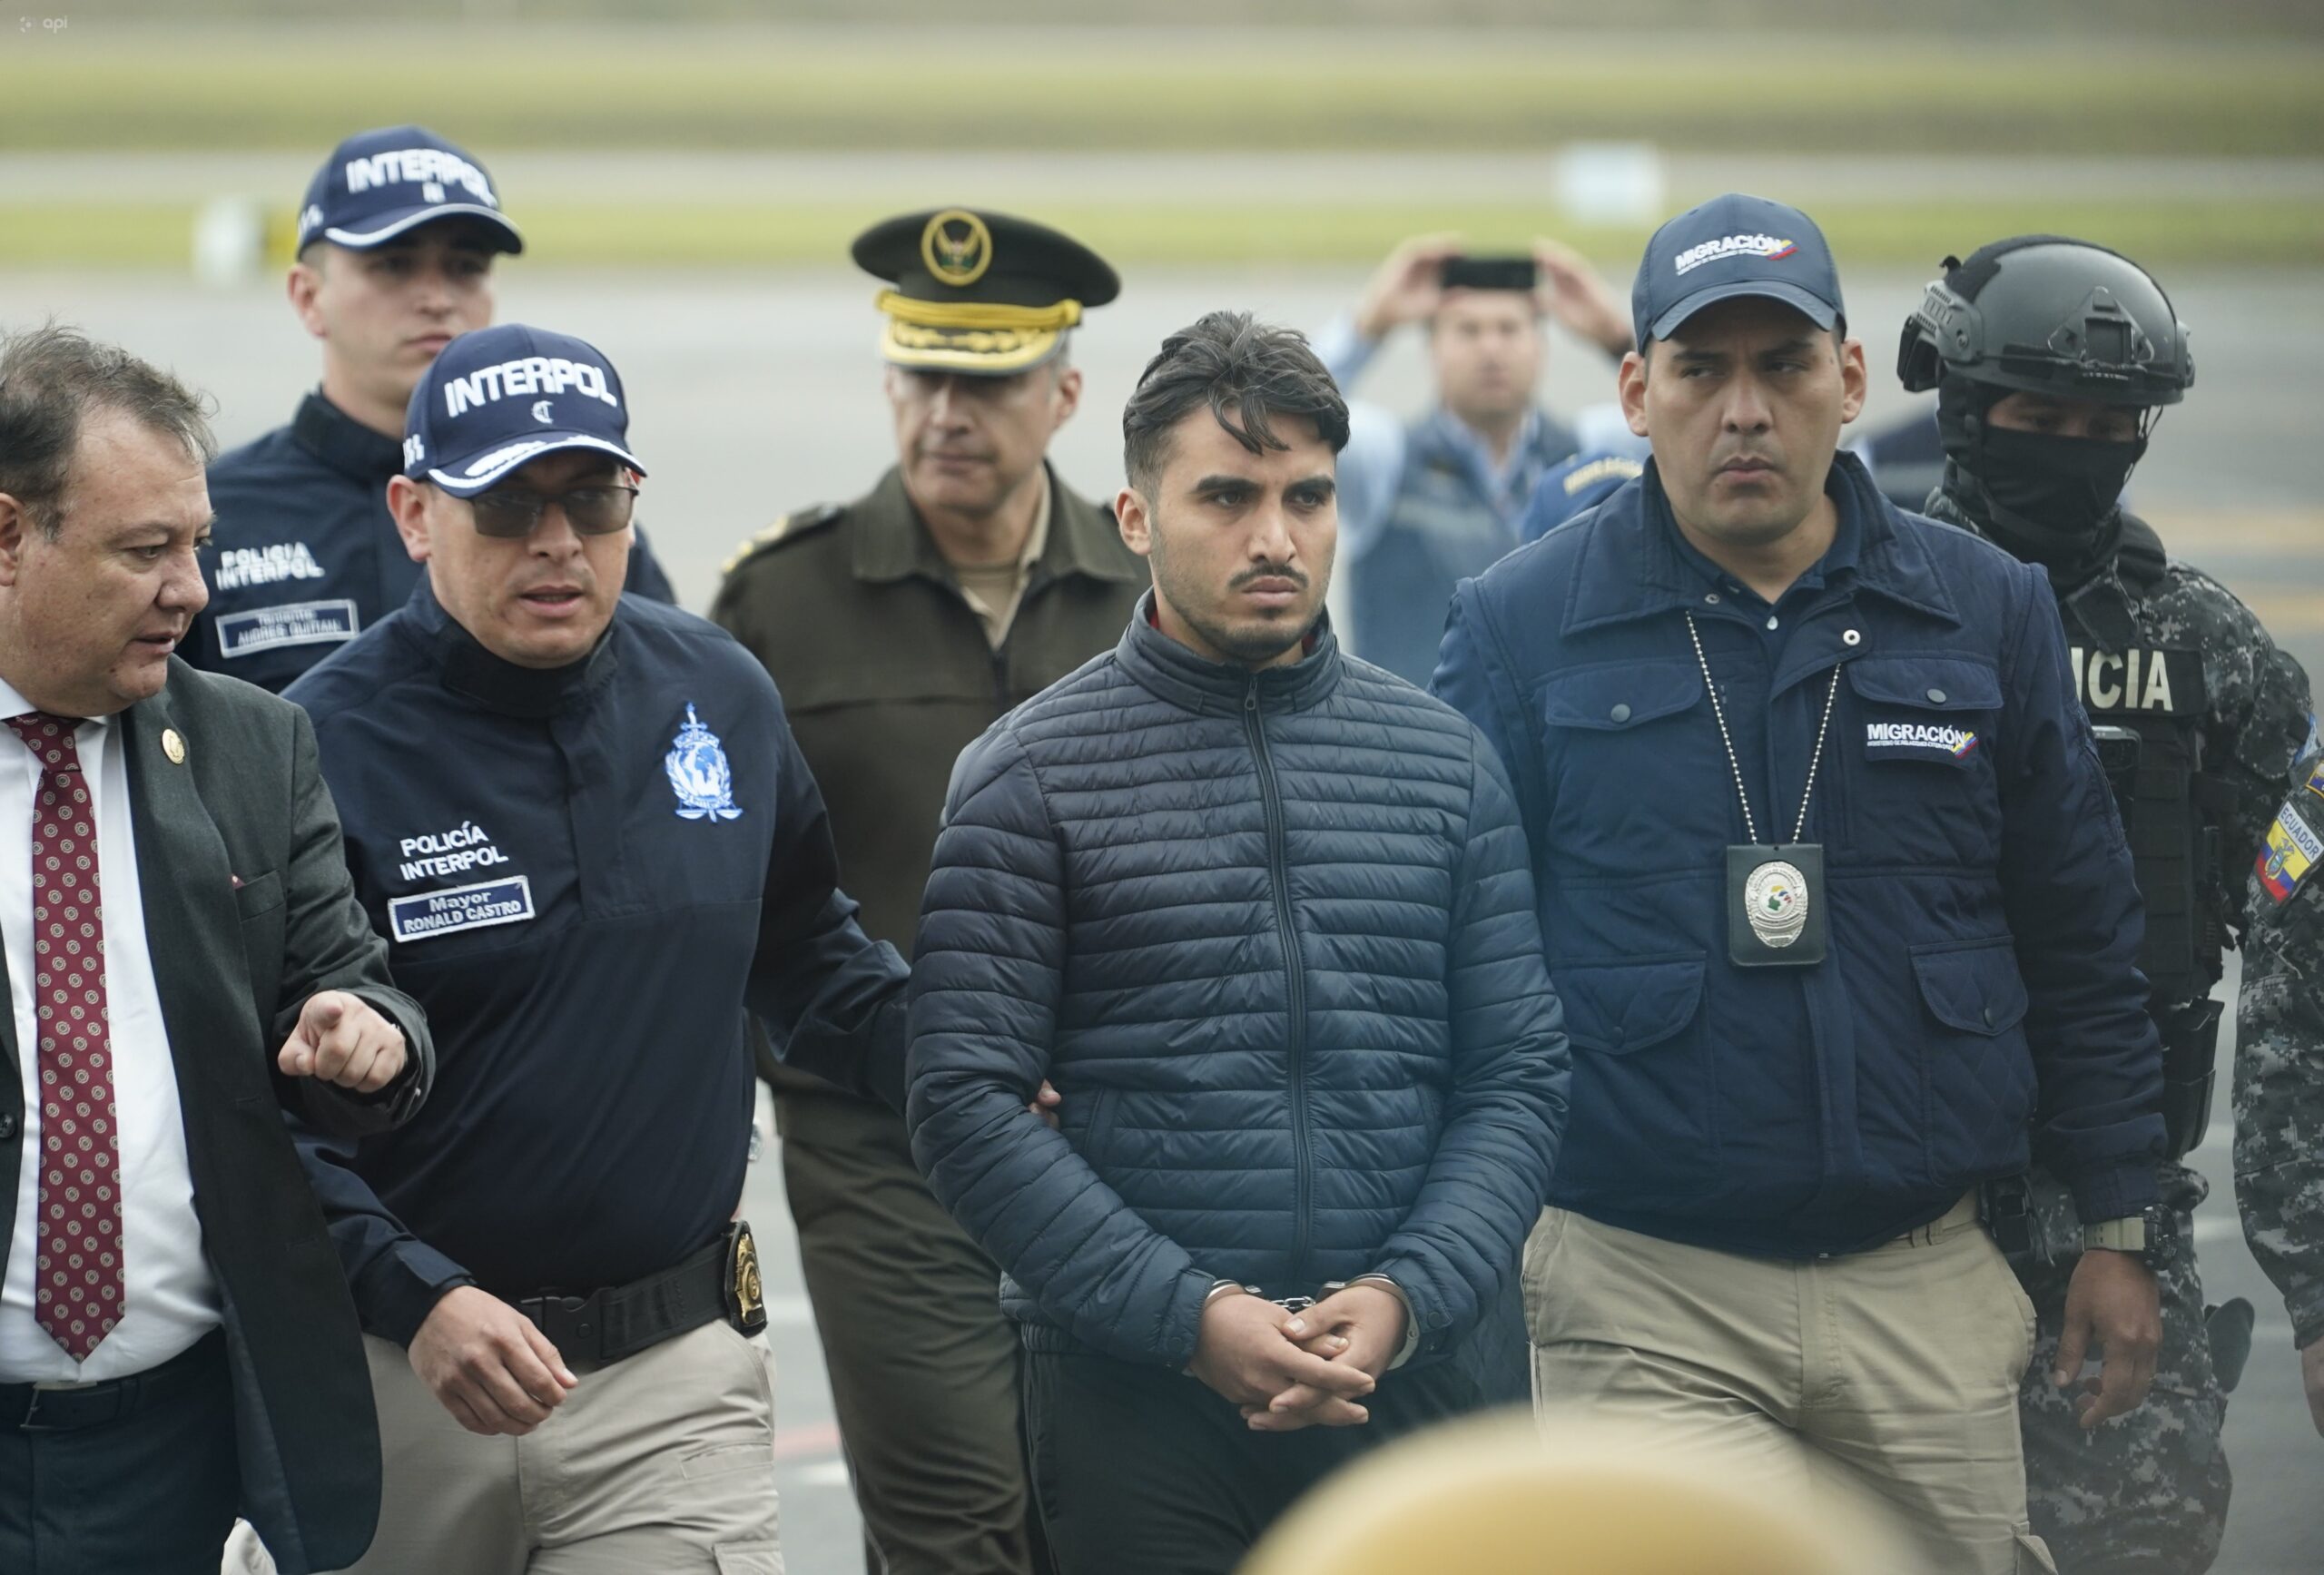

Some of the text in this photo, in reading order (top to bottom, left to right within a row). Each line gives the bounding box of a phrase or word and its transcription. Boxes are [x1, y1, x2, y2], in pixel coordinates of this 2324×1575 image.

[1674, 233, 1782, 271] MIGRACIÓN
[444, 357, 617, 418] INTERPOL
[1867, 724, 1965, 748] MIGRACIÓN
[399, 821, 489, 857] POLICÍA
[2280, 806, 2319, 860] ECUADOR
[399, 846, 509, 881] INTERPOL
[403, 901, 522, 933] RONALD CASTRO
[429, 891, 491, 912] Mayor
